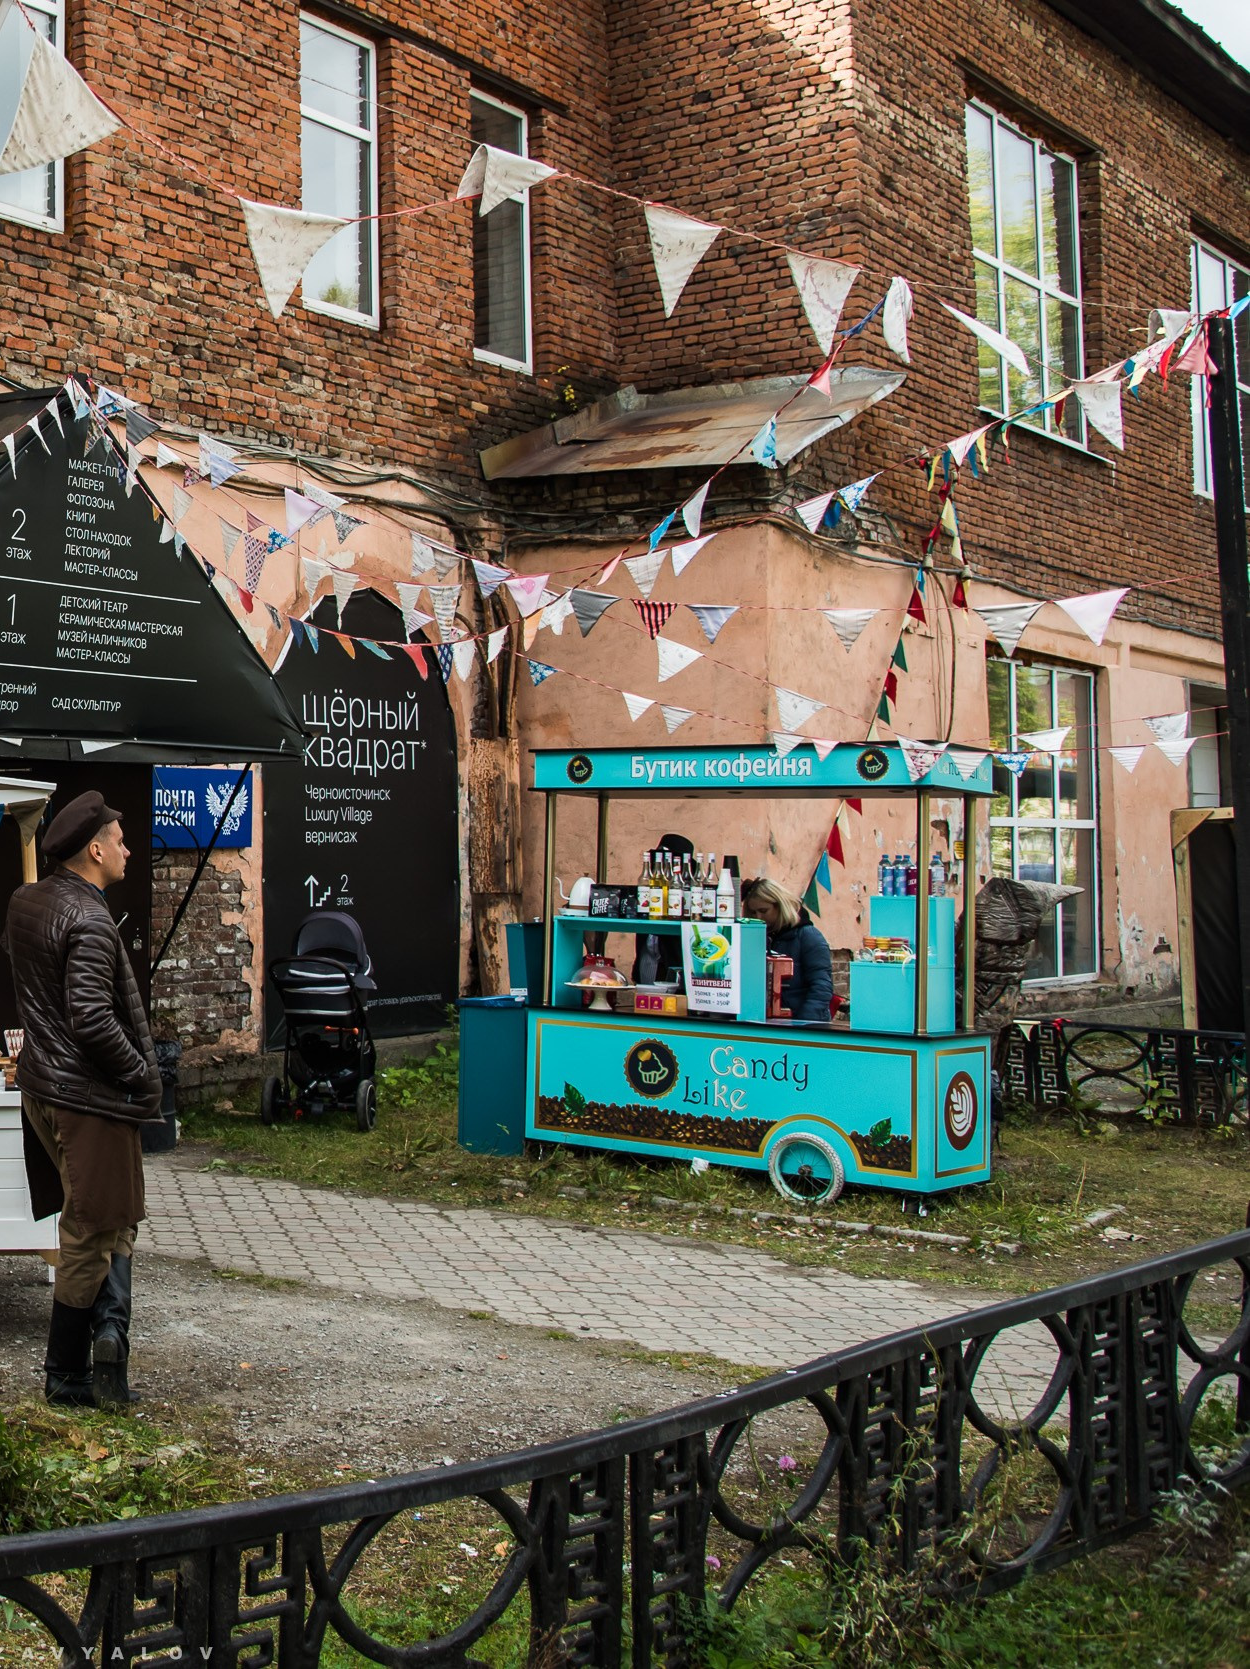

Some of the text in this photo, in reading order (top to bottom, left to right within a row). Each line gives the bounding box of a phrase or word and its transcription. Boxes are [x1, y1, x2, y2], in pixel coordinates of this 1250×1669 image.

[67, 475, 105, 492] ГАЛЕРЕЯ
[67, 493, 115, 510] ФОТОЗОНА
[11, 509, 26, 541] 2
[66, 510, 96, 524] КНИГИ
[65, 527, 132, 547] СТОЛ НАХОДОК
[5, 547, 32, 561] этаж
[65, 543, 110, 560] ЛЕКТОРИЙ
[64, 561, 138, 581] МАСТЕР-КЛАССЫ
[7, 594, 17, 625] 1
[60, 595, 128, 613] ДЕТСКИЙ ТЕАТР
[59, 613, 183, 636] КЕРАМИЧЕСКАЯ МАСТЕРСКАЯ
[0, 631, 26, 645] этаж
[58, 629, 147, 649] МУЗЕЙ НАЛИЧНИКОВ
[57, 647, 131, 664] МАСТЕР-КЛАССЫ
[52, 698, 121, 712] САД СКУЛЬПТУР
[302, 688, 419, 736] щёрный
[631, 752, 812, 782] Бутик кофейня
[155, 789, 196, 808] ПОЧТА
[305, 784, 391, 802] Черноисточинск
[155, 810, 196, 828] РОССИИ
[305, 806, 373, 824] Luxury Village
[305, 831, 358, 845] вернисаж
[340, 874, 349, 892] 2
[336, 896, 354, 906] этаж
[692, 979, 731, 988] ГЛИНТВЕЙН
[709, 1046, 810, 1092] Candy
[683, 1074, 749, 1112] Like
